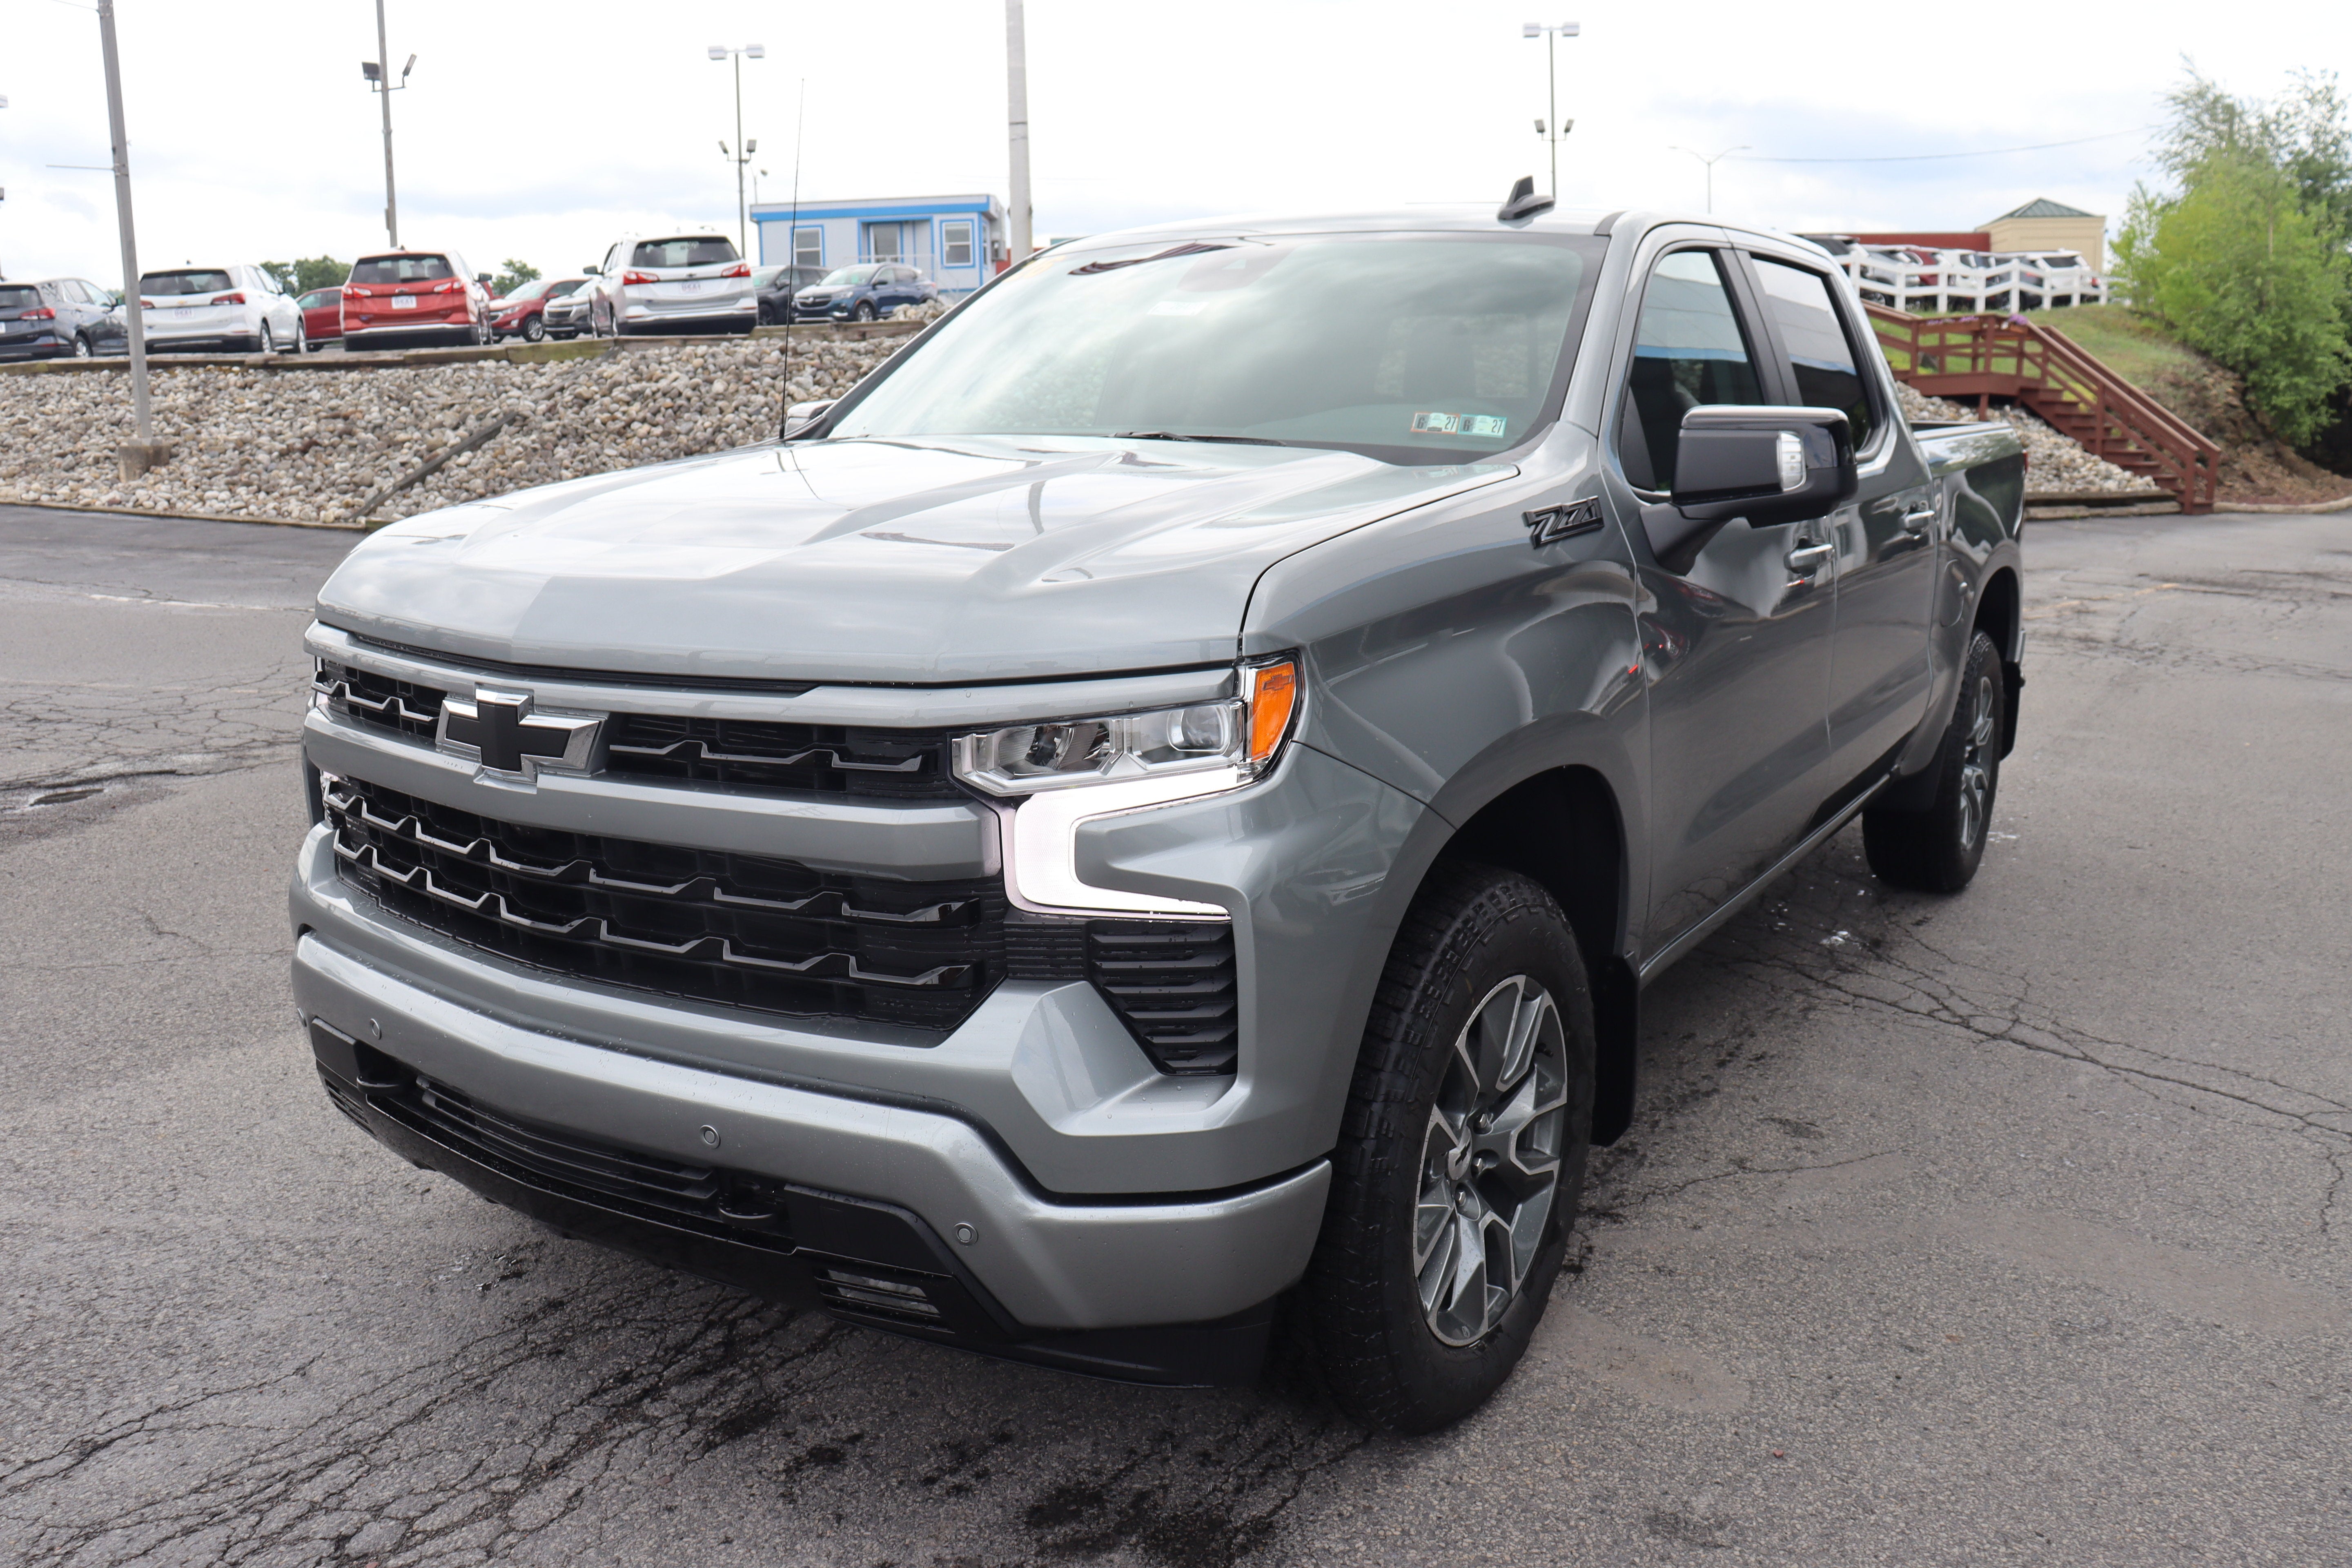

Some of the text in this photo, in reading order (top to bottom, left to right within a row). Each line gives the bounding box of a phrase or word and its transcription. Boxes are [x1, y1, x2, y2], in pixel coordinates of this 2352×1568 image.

[1417, 416, 1457, 431] 6 27
[1463, 419, 1503, 434] 6 27
[1521, 495, 1605, 550] Z71
